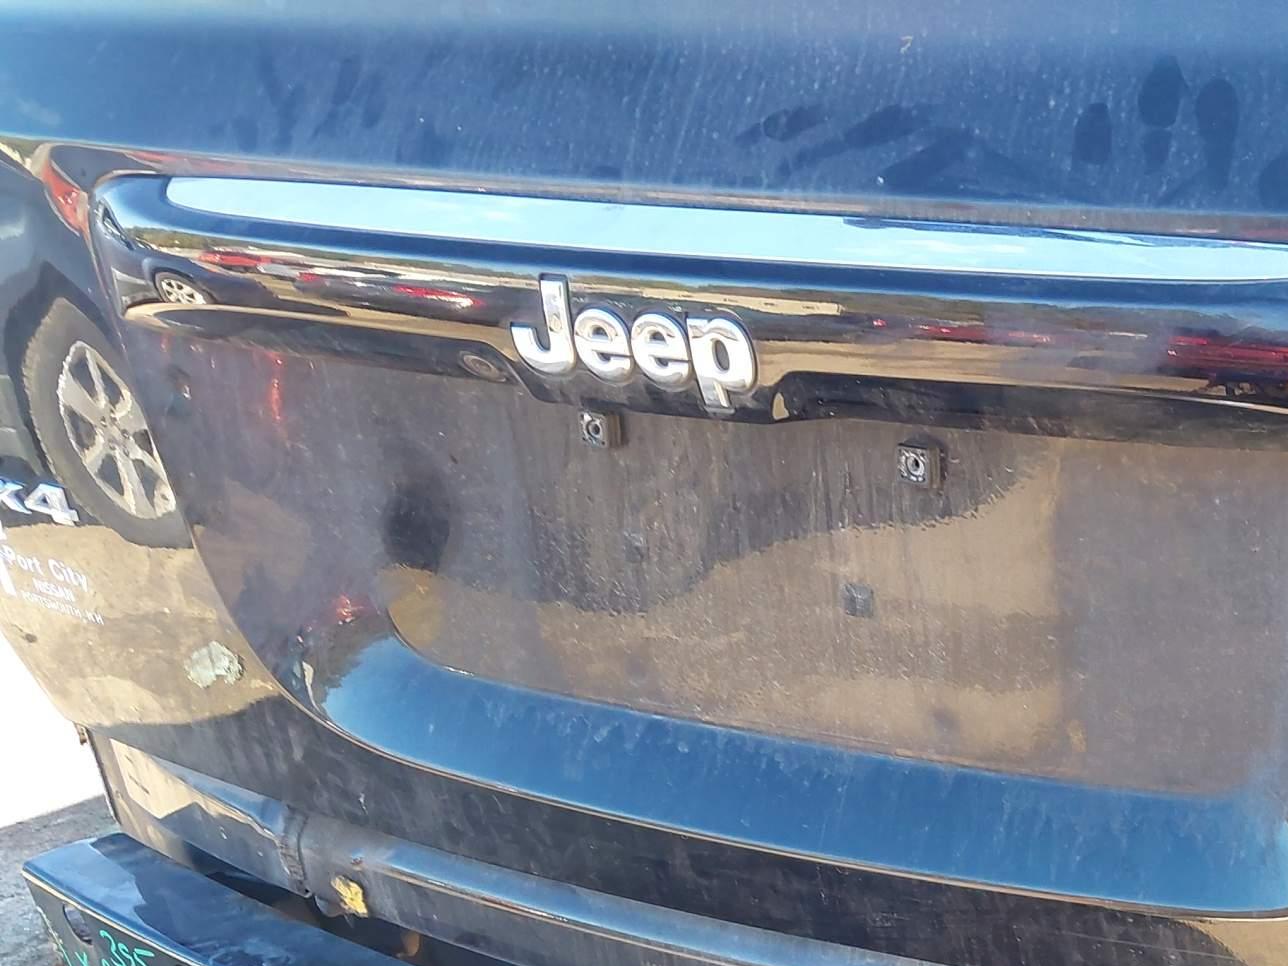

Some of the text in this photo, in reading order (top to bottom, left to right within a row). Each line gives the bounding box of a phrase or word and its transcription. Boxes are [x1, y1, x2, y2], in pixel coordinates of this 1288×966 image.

[510, 273, 758, 413] Jeep
[1, 544, 89, 592] Port City
[32, 577, 76, 602] NISSAN
